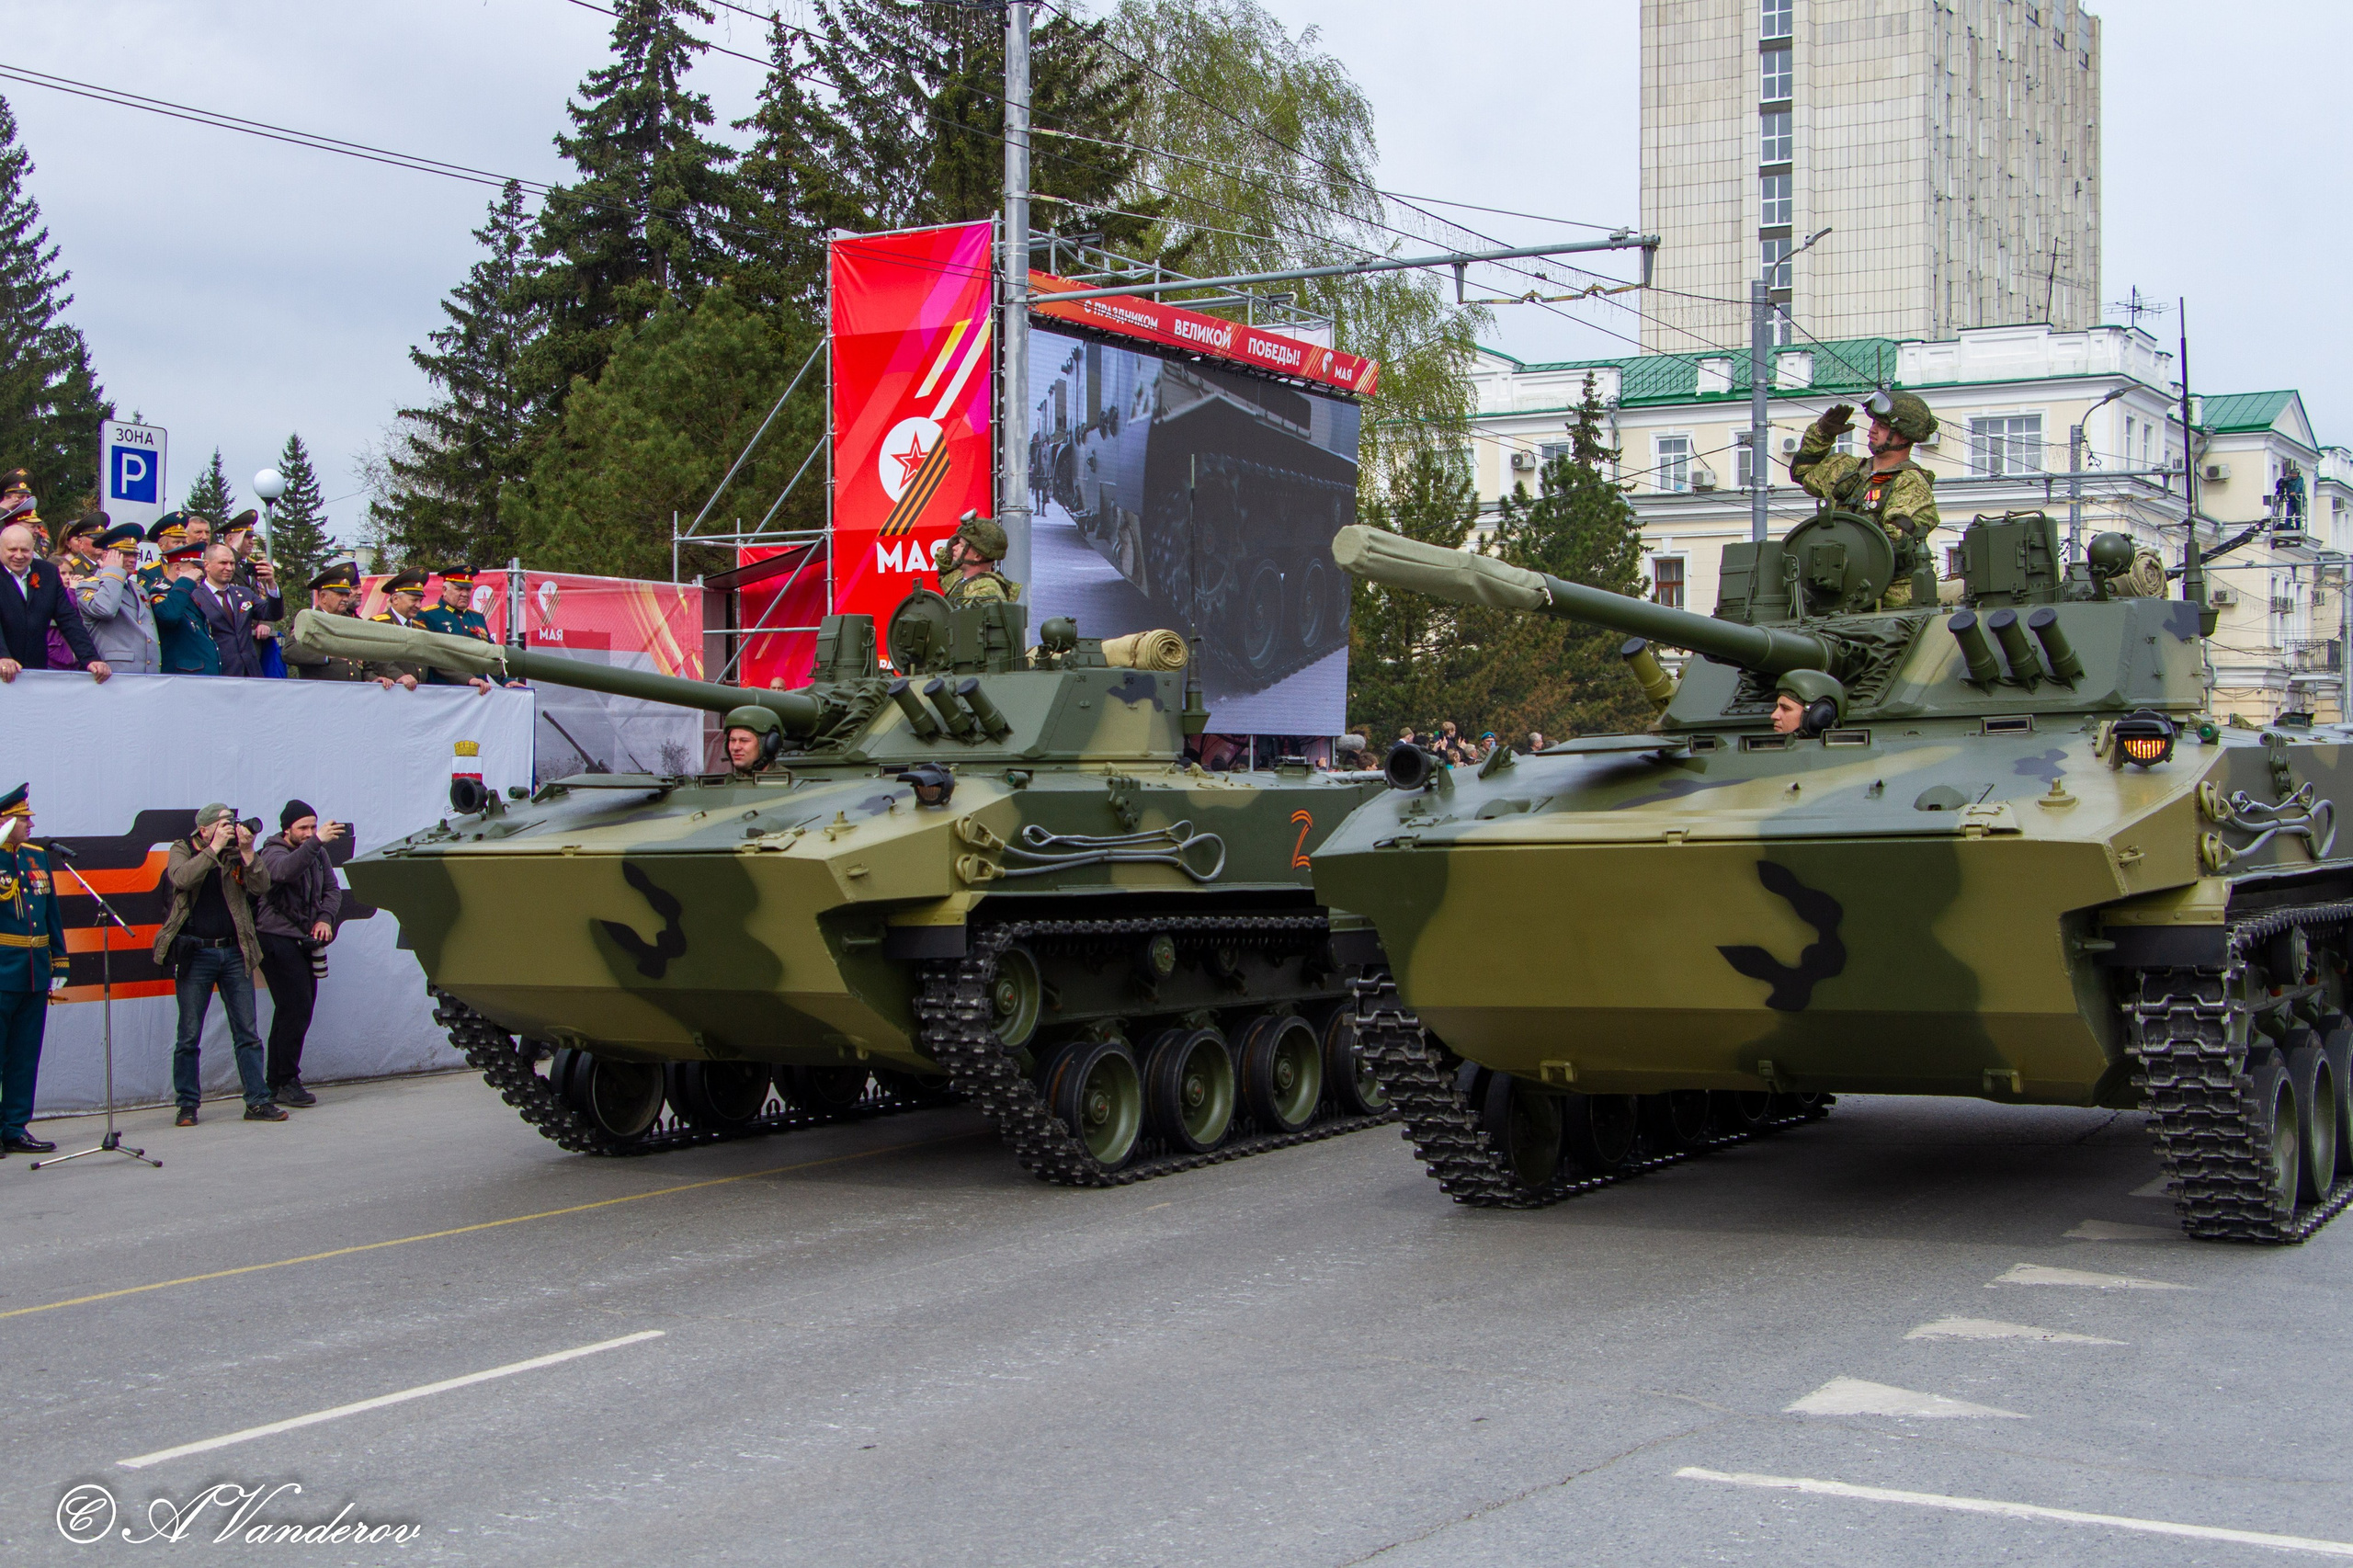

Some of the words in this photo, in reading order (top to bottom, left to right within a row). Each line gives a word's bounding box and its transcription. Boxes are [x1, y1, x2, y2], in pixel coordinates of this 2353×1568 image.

[1094, 301, 1159, 331] ПРАЗДНИКОМ
[1174, 318, 1232, 349] ВЕЛИКОЙ
[1247, 336, 1302, 367] ПОБЕДЫ!
[1334, 365, 1353, 382] МАЯ
[116, 427, 154, 446] ЗОНА
[120, 452, 147, 494] P
[539, 627, 563, 642] МАЯ
